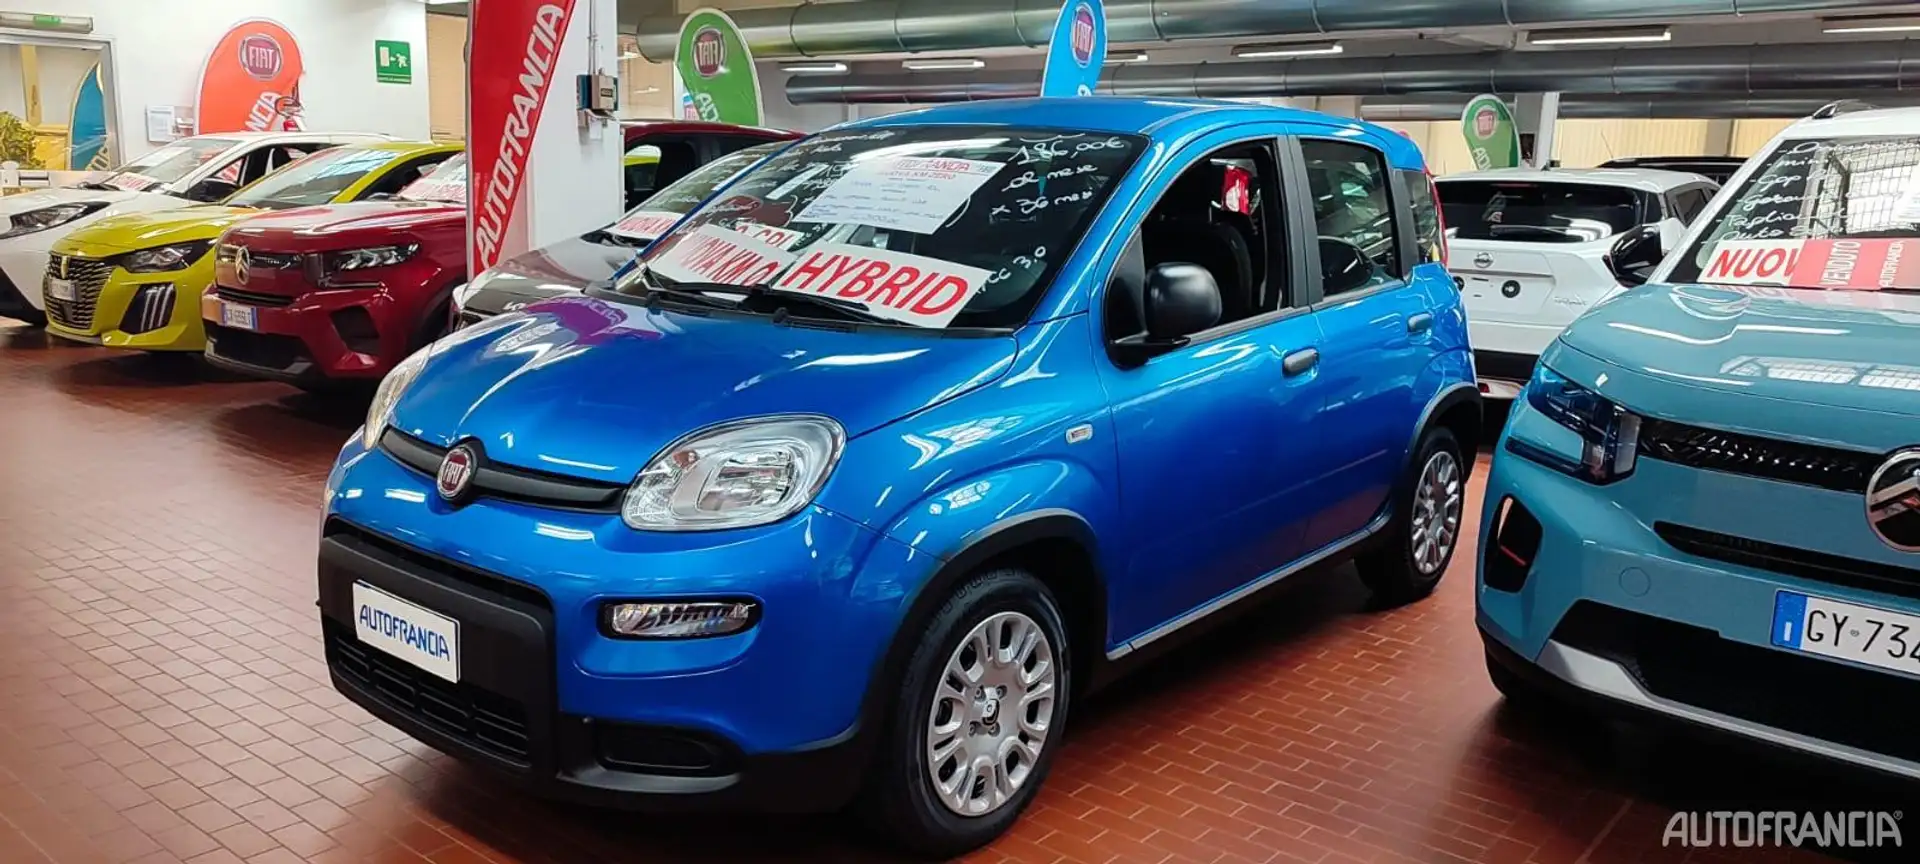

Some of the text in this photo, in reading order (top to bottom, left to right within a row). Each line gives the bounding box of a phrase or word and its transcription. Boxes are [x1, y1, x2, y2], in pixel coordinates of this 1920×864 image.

[1076, 19, 1092, 53] FIAT
[248, 45, 275, 69] FIAT
[476, 3, 565, 269] AUTOFRANCIA
[1016, 196, 1049, 214] 36
[1819, 241, 1861, 286] VENDUTO
[783, 251, 970, 316] HYBRID
[443, 461, 465, 484] FIAT
[360, 604, 450, 662] AUTOFRANCIA
